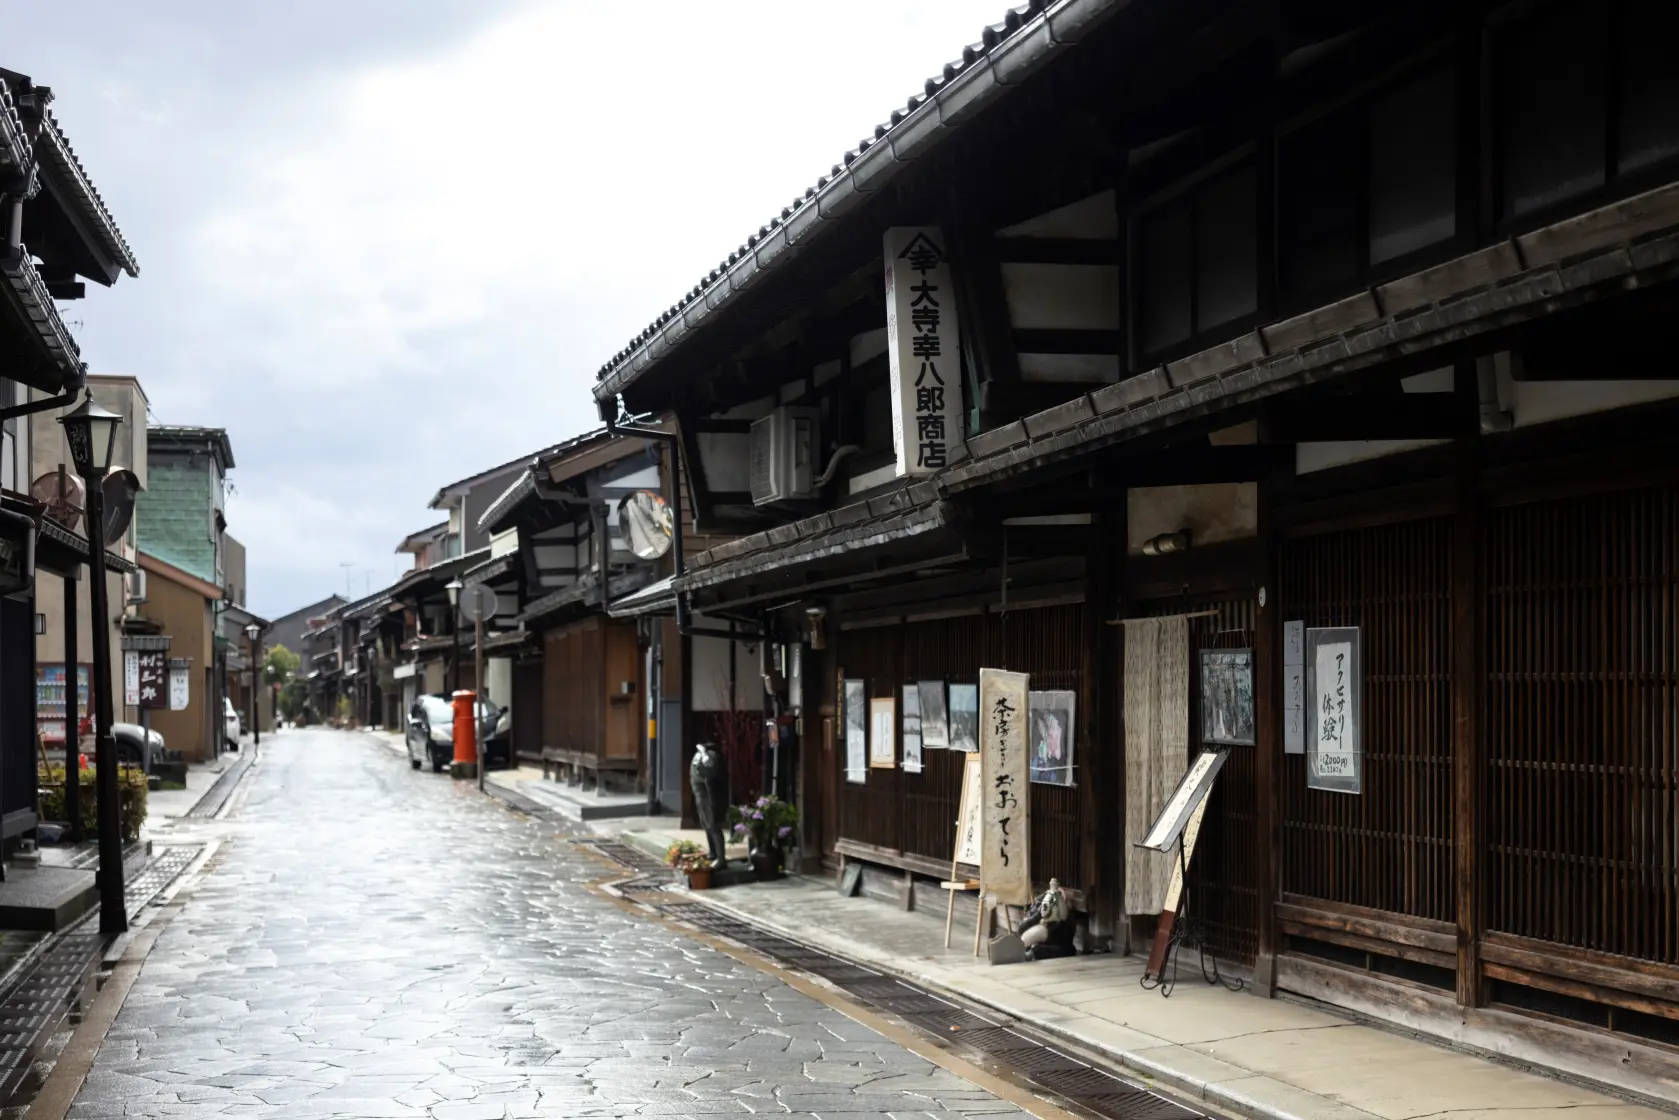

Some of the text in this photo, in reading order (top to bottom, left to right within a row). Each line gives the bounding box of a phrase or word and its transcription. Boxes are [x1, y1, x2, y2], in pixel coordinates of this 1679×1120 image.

[910, 279, 946, 468] 大寺幸八郎商店
[1321, 693, 1338, 741] 体験
[1335, 652, 1345, 750] アクセサリー
